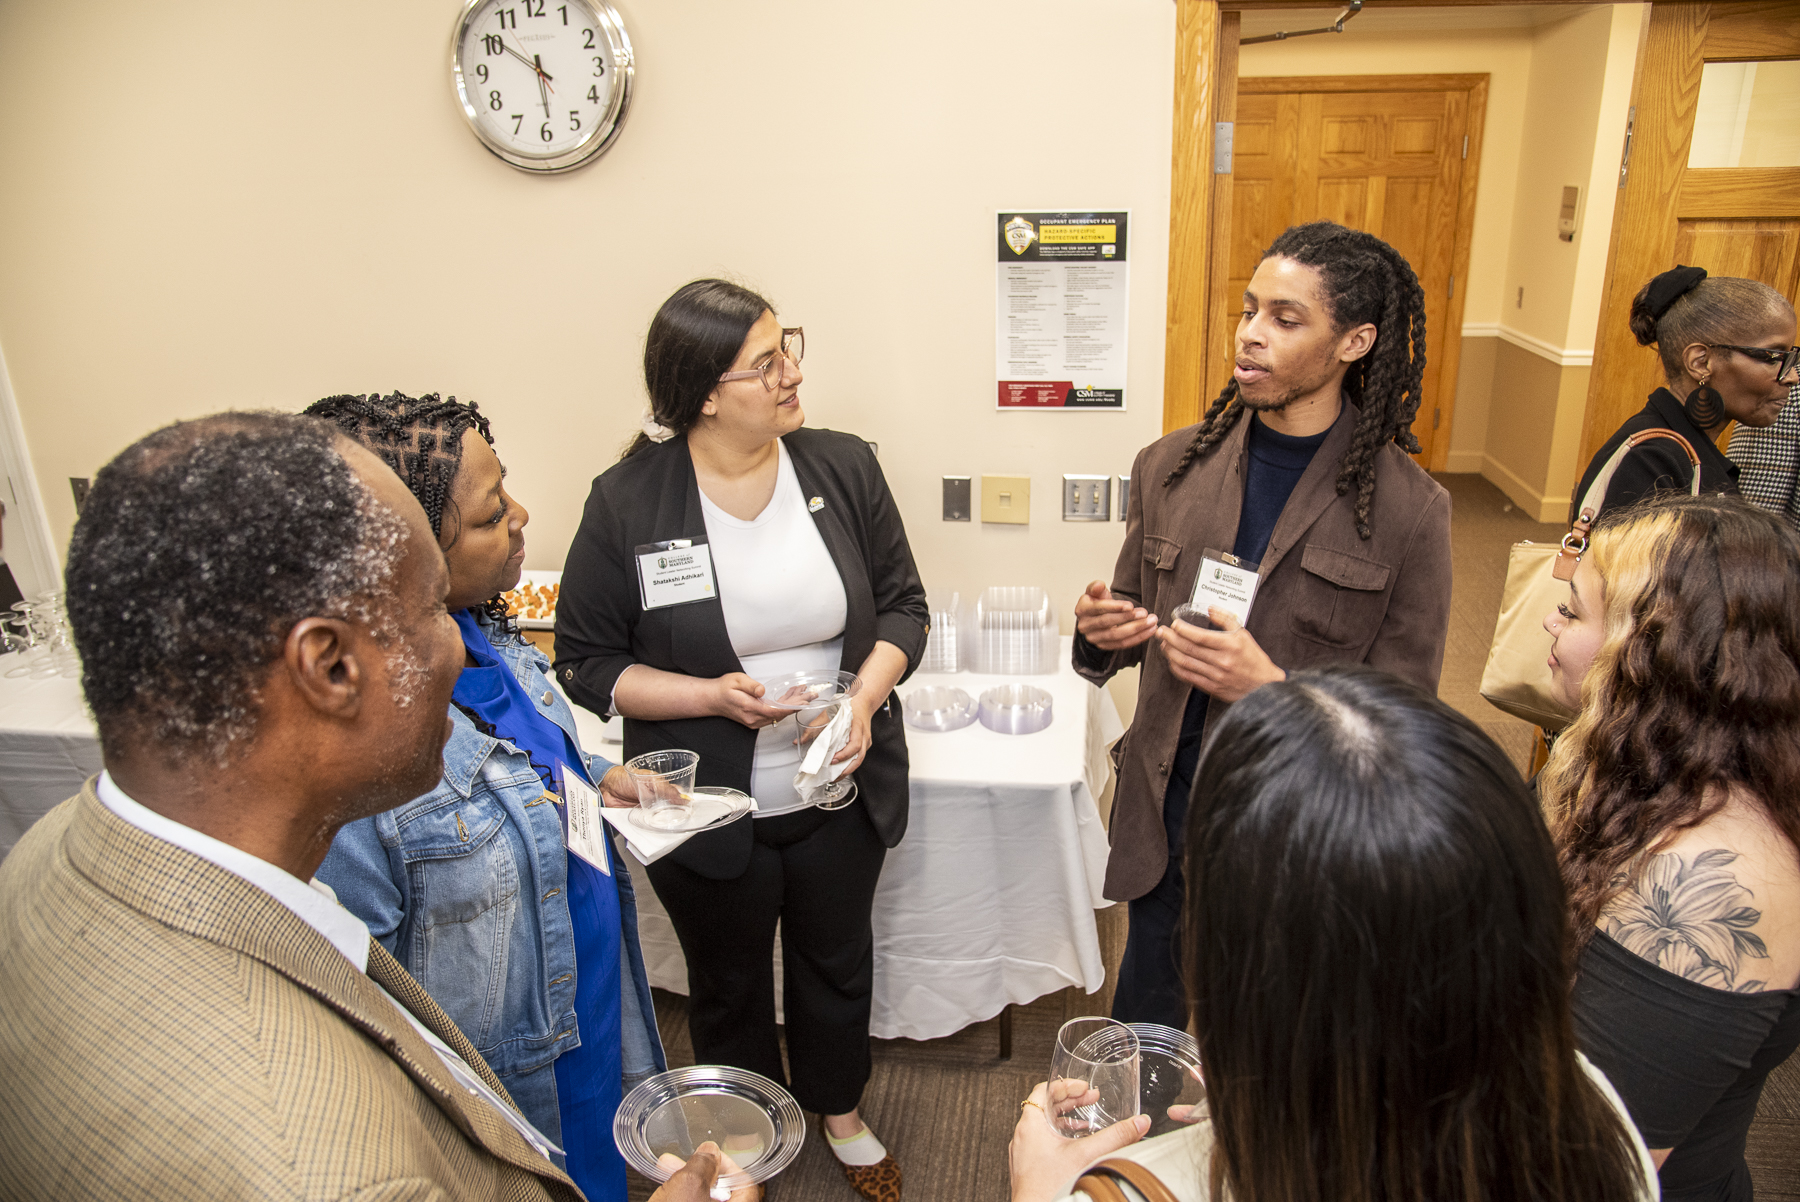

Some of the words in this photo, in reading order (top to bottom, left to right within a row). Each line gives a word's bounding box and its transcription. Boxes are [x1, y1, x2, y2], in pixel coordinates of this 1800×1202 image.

[495, 8, 516, 29] 11
[522, 0, 546, 17] 12
[557, 5, 568, 26] 1
[481, 34, 503, 56] 10
[582, 28, 595, 49] 2
[476, 64, 489, 84] 9
[592, 57, 604, 77] 3
[490, 90, 503, 111] 8
[587, 85, 600, 104] 4
[511, 114, 524, 135] 7
[569, 111, 581, 131] 5
[540, 122, 553, 142] 6
[653, 576, 680, 586] Shatakshi
[681, 572, 704, 580] Adhikari
[1201, 584, 1228, 596] Christopher
[1228, 593, 1247, 602] Johnson
